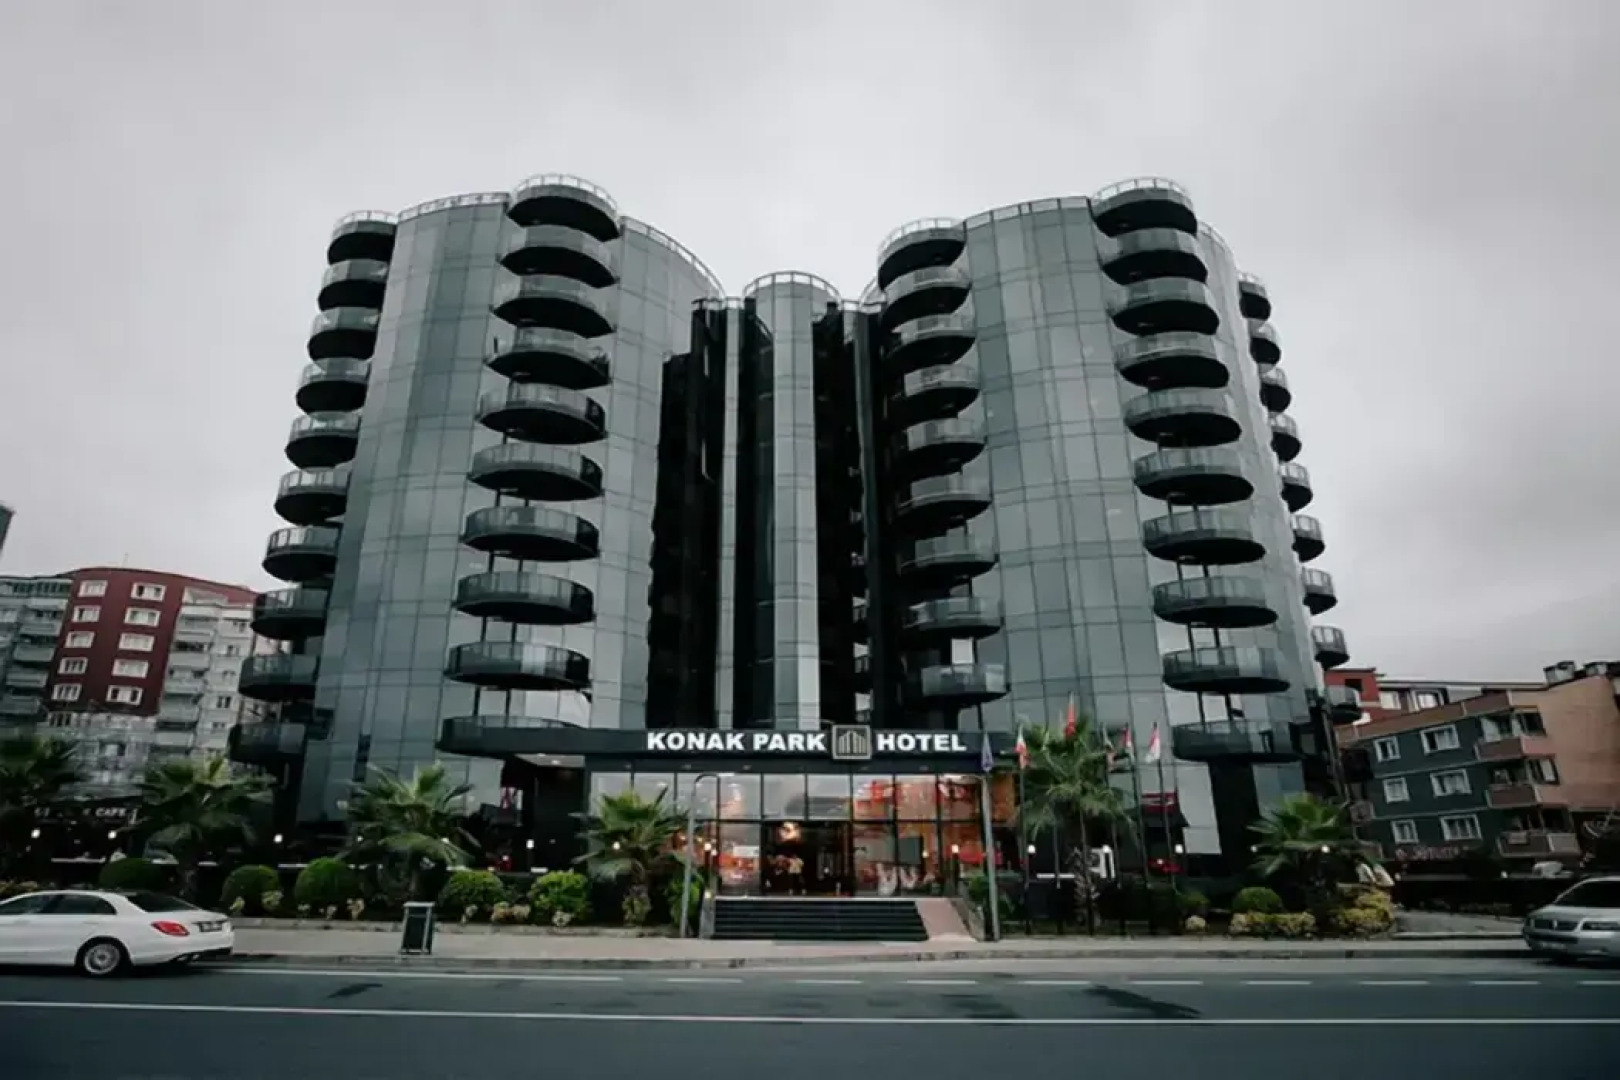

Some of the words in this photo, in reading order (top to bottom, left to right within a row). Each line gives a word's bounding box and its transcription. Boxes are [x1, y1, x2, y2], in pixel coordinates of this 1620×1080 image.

[647, 732, 744, 750] KONAK
[752, 733, 826, 750] PARK
[876, 733, 967, 751] HOTEL
